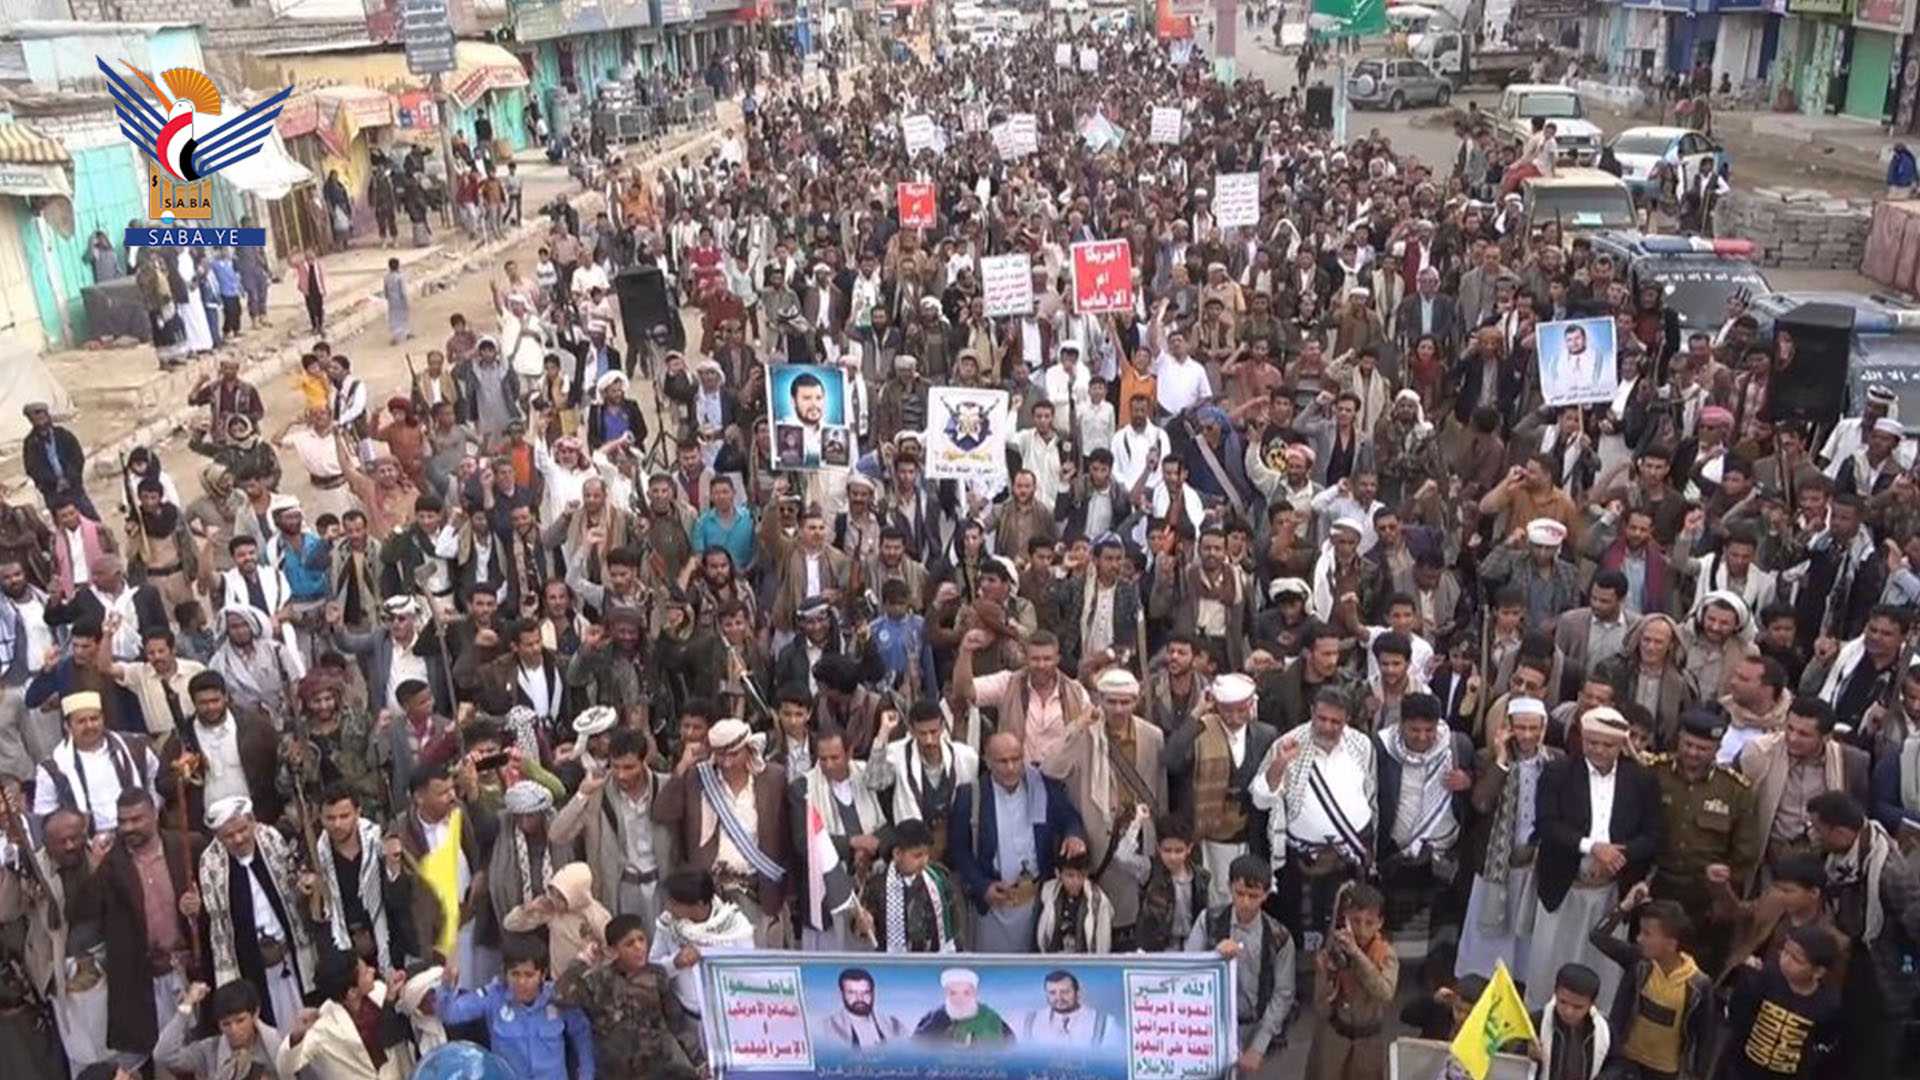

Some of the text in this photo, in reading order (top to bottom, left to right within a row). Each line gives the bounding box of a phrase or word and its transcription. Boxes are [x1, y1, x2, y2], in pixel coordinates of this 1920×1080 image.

[722, 975, 796, 997] قاطعوا
[1182, 977, 1212, 996] الله
[1178, 1005, 1212, 1018] الموت
[1178, 1023, 1213, 1037] الموت
[1135, 1040, 1213, 1057] اللعنة على اليهود
